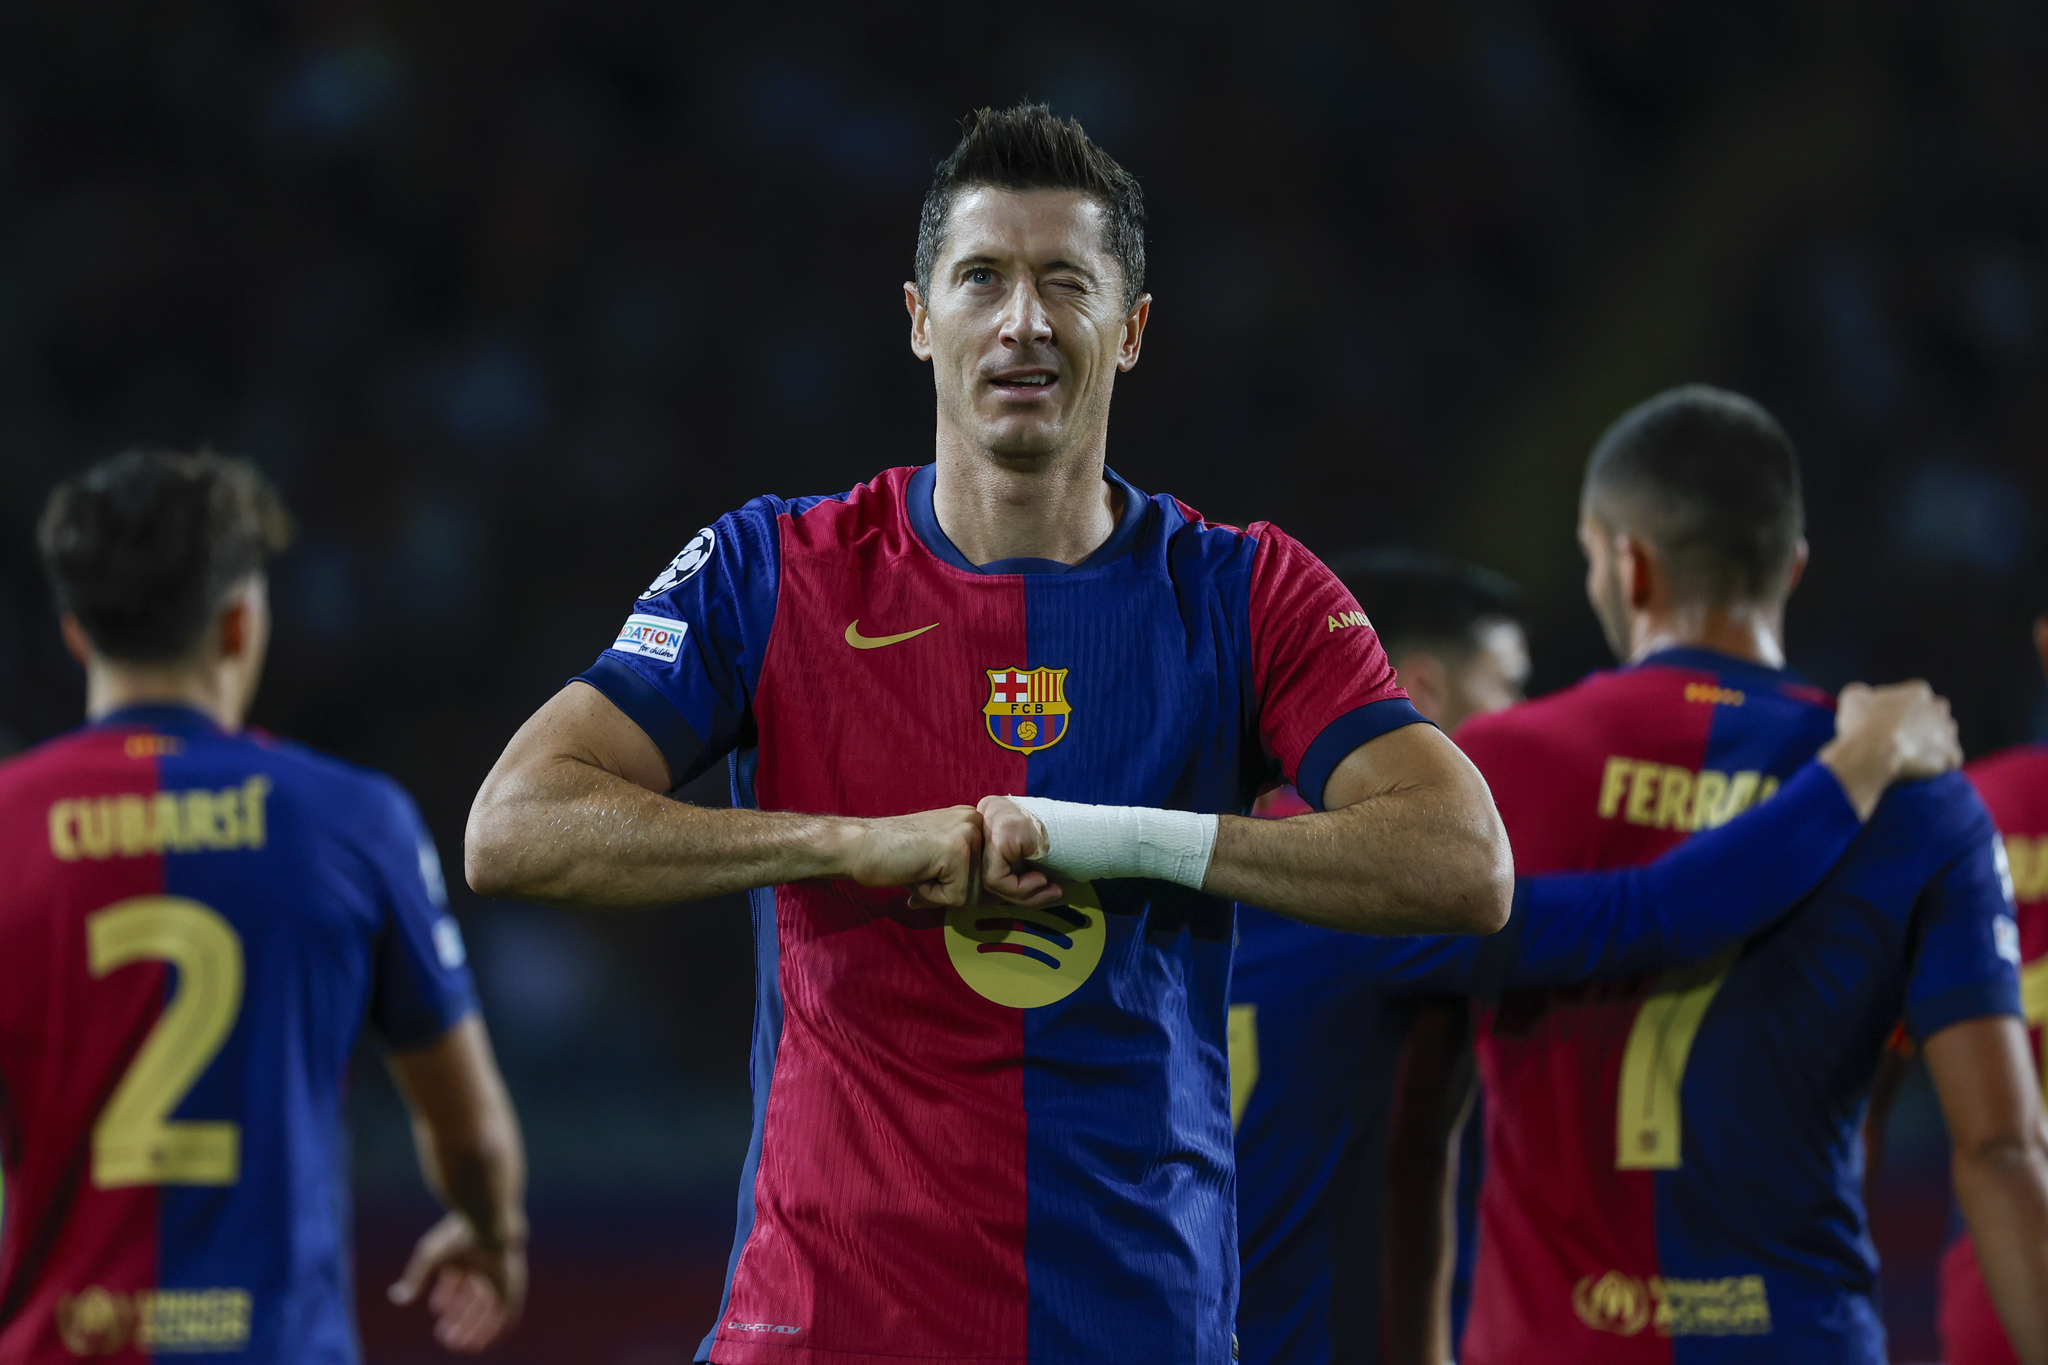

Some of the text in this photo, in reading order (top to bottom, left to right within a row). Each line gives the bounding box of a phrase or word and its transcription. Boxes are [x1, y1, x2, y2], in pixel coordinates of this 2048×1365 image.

[638, 643, 674, 658] for children
[48, 775, 271, 861] CUBARSÍ
[85, 895, 246, 1190] 2
